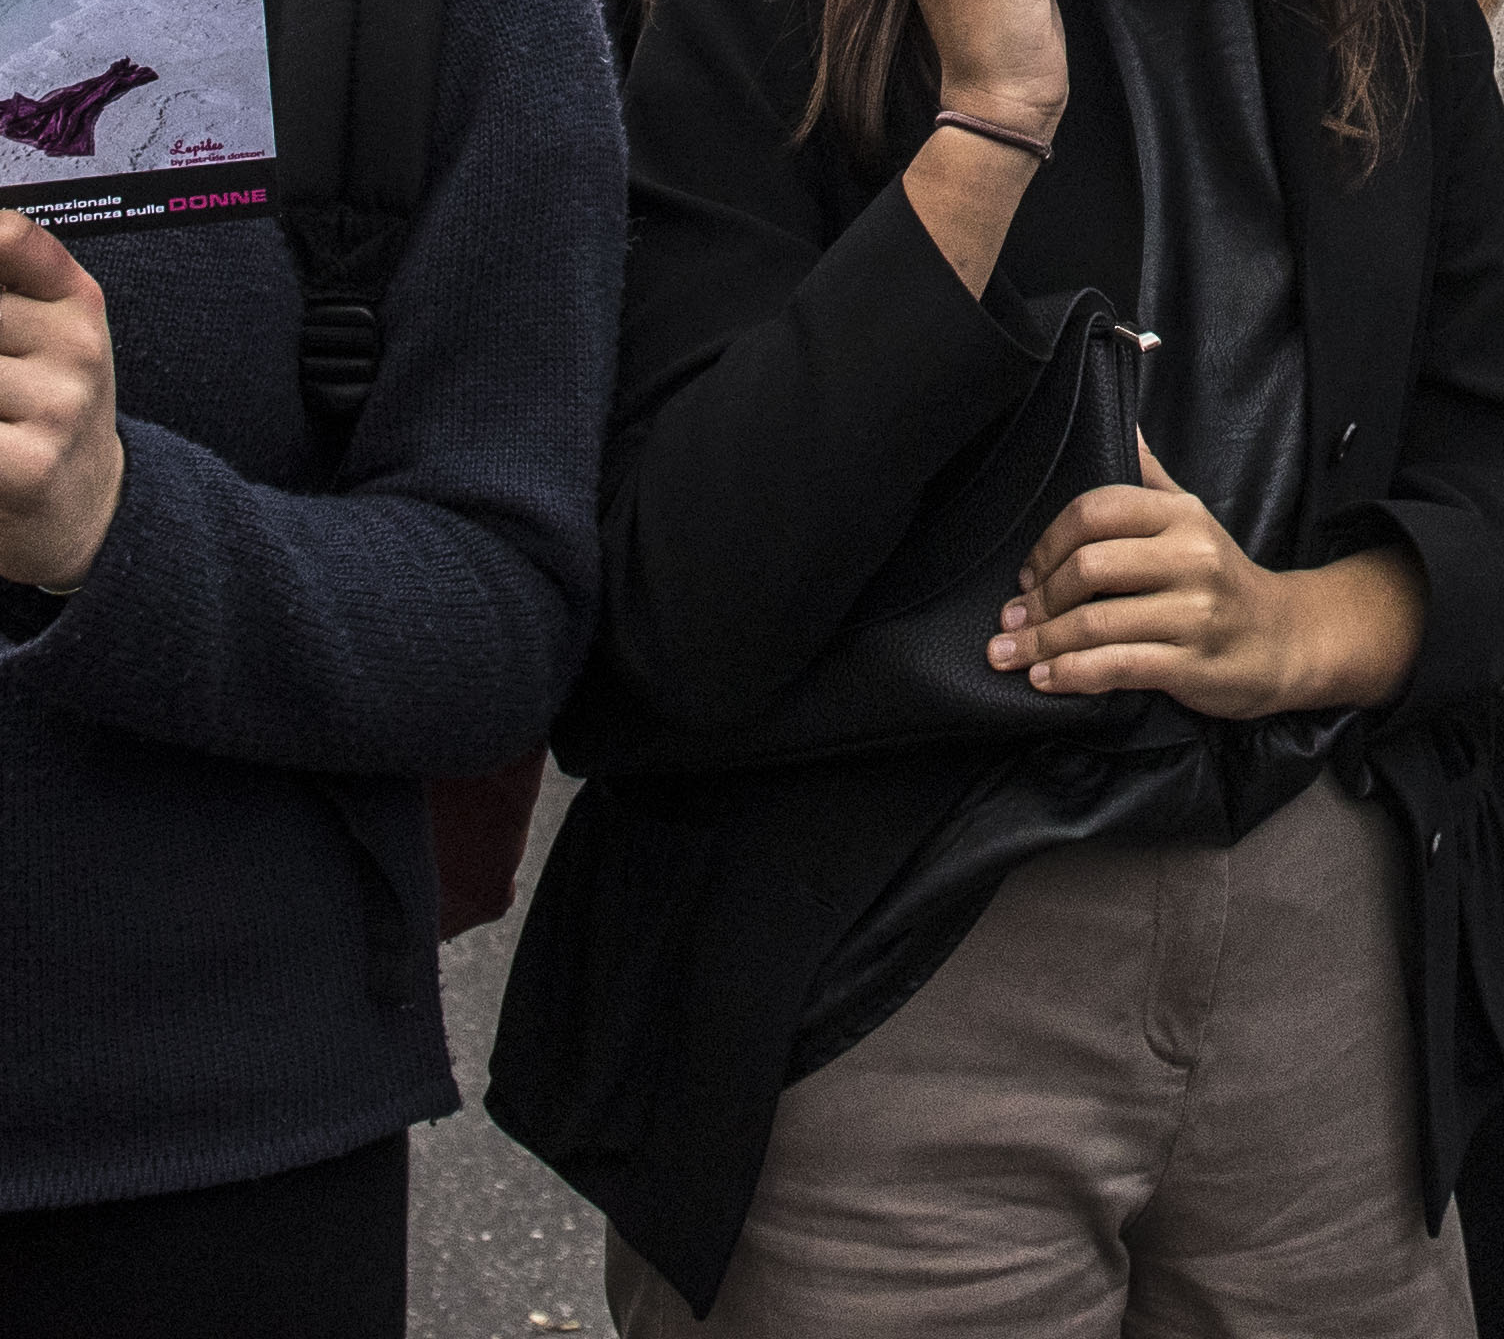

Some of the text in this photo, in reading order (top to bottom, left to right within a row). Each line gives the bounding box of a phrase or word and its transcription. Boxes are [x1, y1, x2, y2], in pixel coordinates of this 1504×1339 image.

[54, 210, 122, 224] violenza
[126, 204, 165, 217] sulle
[168, 188, 268, 212] DONNE
